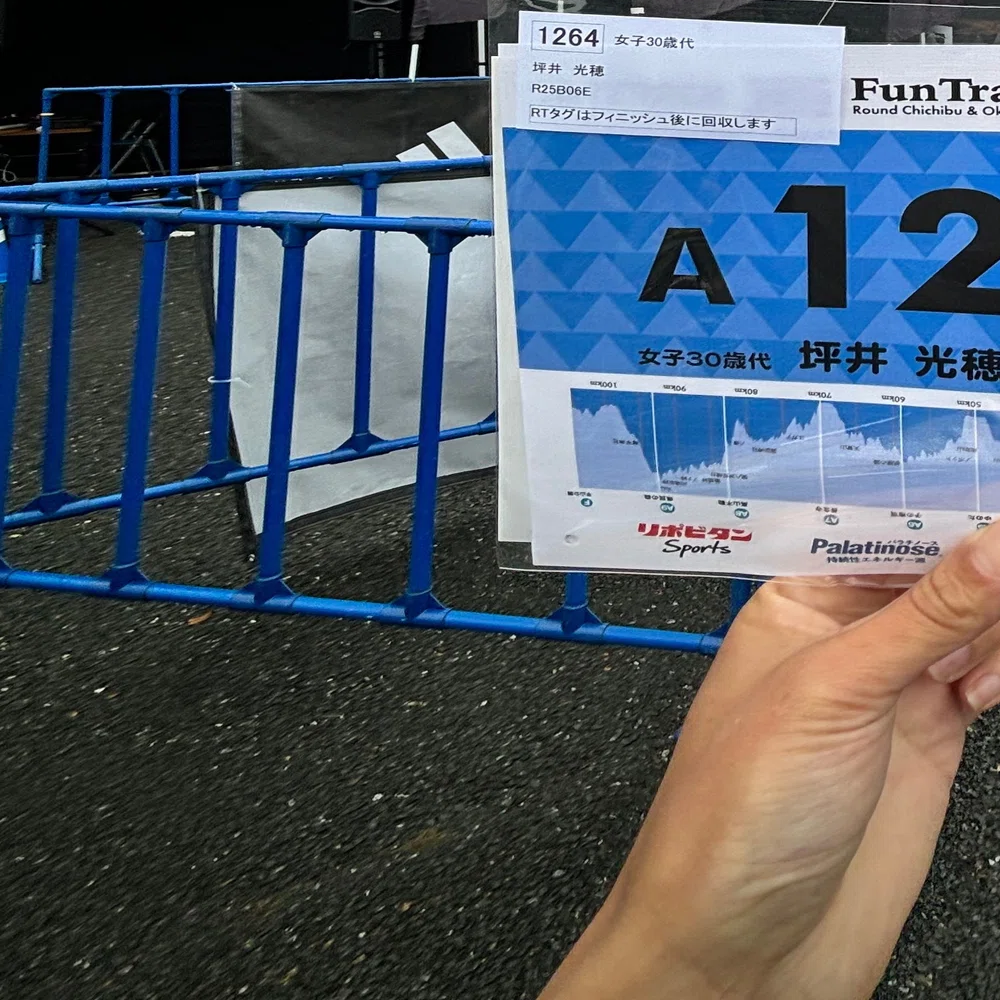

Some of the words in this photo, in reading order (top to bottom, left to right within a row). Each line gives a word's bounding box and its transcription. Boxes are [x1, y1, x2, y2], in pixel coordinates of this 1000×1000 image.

[538, 26, 600, 47] 1264
[614, 34, 695, 50] 女子30歳代
[532, 62, 562, 75] 坪井
[573, 63, 605, 77] 光穂
[531, 83, 592, 97] R25B06E
[853, 105, 897, 115] Round
[902, 105, 962, 116] Chichibu
[967, 106, 978, 116] &
[531, 106, 776, 131] RTタグはフィニッシュ後に回収します
[637, 227, 735, 305] A
[638, 347, 772, 372] 女子30歳代
[799, 340, 888, 374] 坪井
[590, 380, 617, 388] 100km
[663, 384, 687, 392] 90km
[734, 387, 758, 395] 80km
[807, 391, 832, 399] 70km
[881, 394, 906, 403] 60km
[956, 399, 982, 408] 50km
[637, 522, 753, 543] リポビタン
[662, 539, 732, 557] Sports
[810, 538, 940, 557] Palatinose
